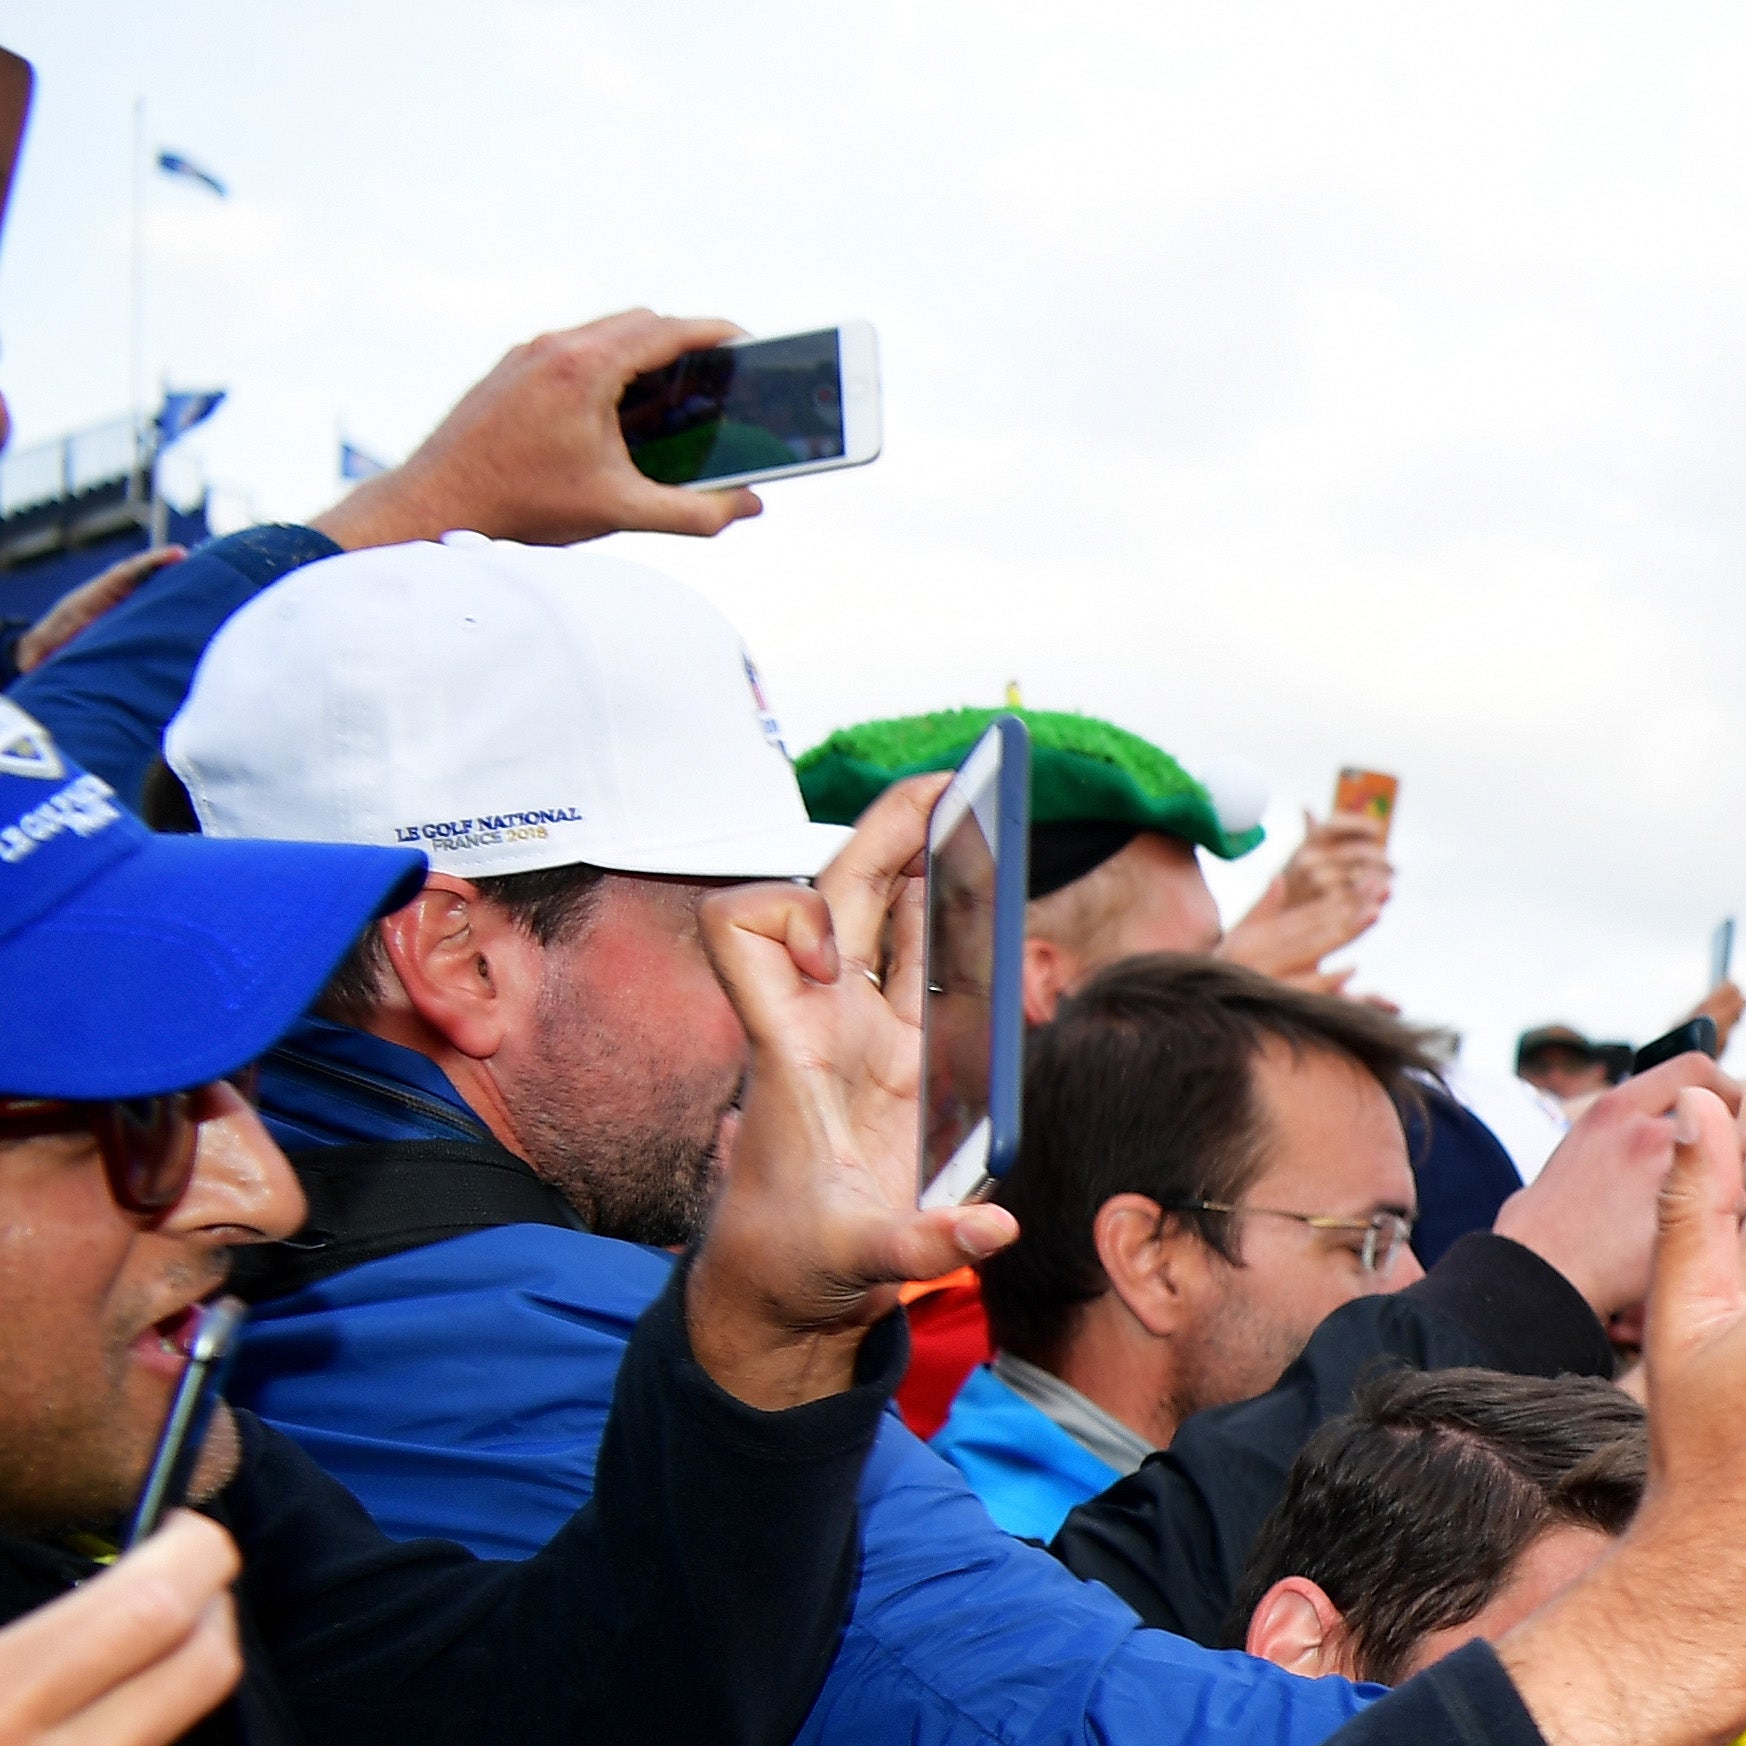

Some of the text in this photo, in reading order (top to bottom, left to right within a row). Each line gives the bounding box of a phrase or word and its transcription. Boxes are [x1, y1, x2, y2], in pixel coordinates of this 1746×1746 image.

[395, 807, 583, 842] LE GOLF NATIONAL
[432, 825, 548, 852] FRANCE 2018
